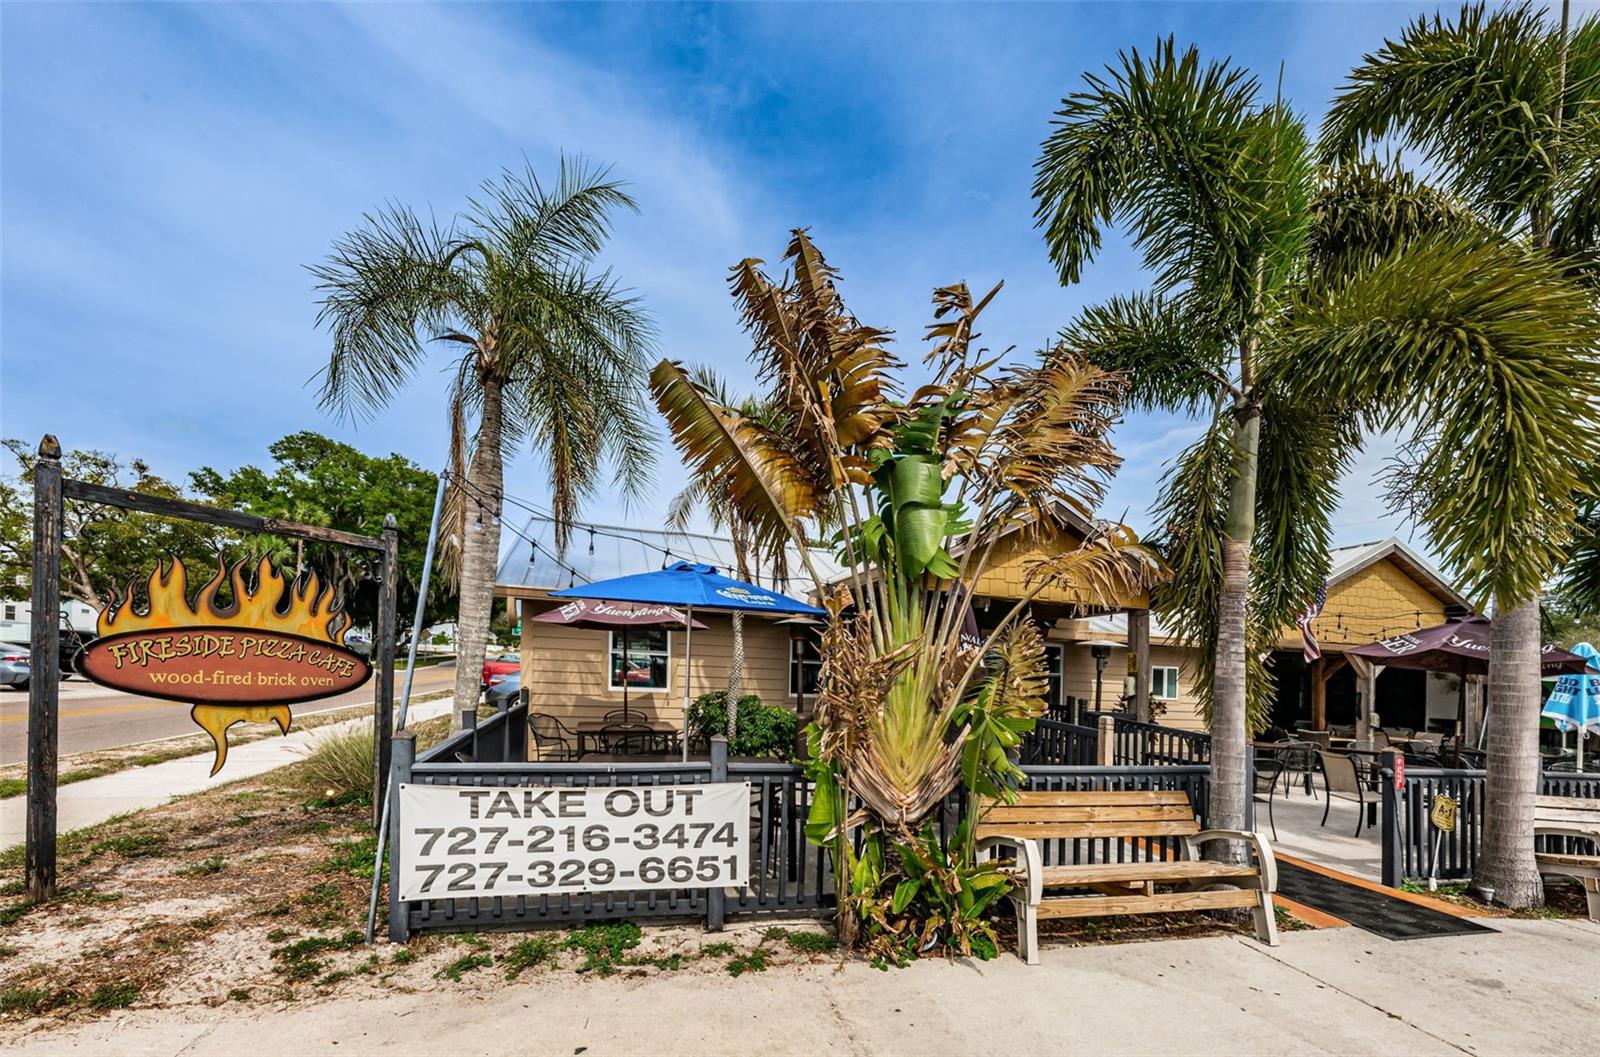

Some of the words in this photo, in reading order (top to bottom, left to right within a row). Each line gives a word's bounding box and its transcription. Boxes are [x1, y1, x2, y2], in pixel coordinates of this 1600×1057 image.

[588, 602, 671, 619] Yuengling
[108, 634, 236, 668] FIRESIDE
[238, 635, 306, 663] PIZZA
[307, 650, 356, 678] CAFE
[149, 670, 252, 686] wood-fired
[257, 671, 296, 687] brick
[301, 675, 334, 687] oven
[458, 789, 587, 820] TAKE
[604, 789, 703, 818] OUT
[414, 821, 739, 857] 727-216-3474
[414, 855, 738, 894] 727-329-6651
